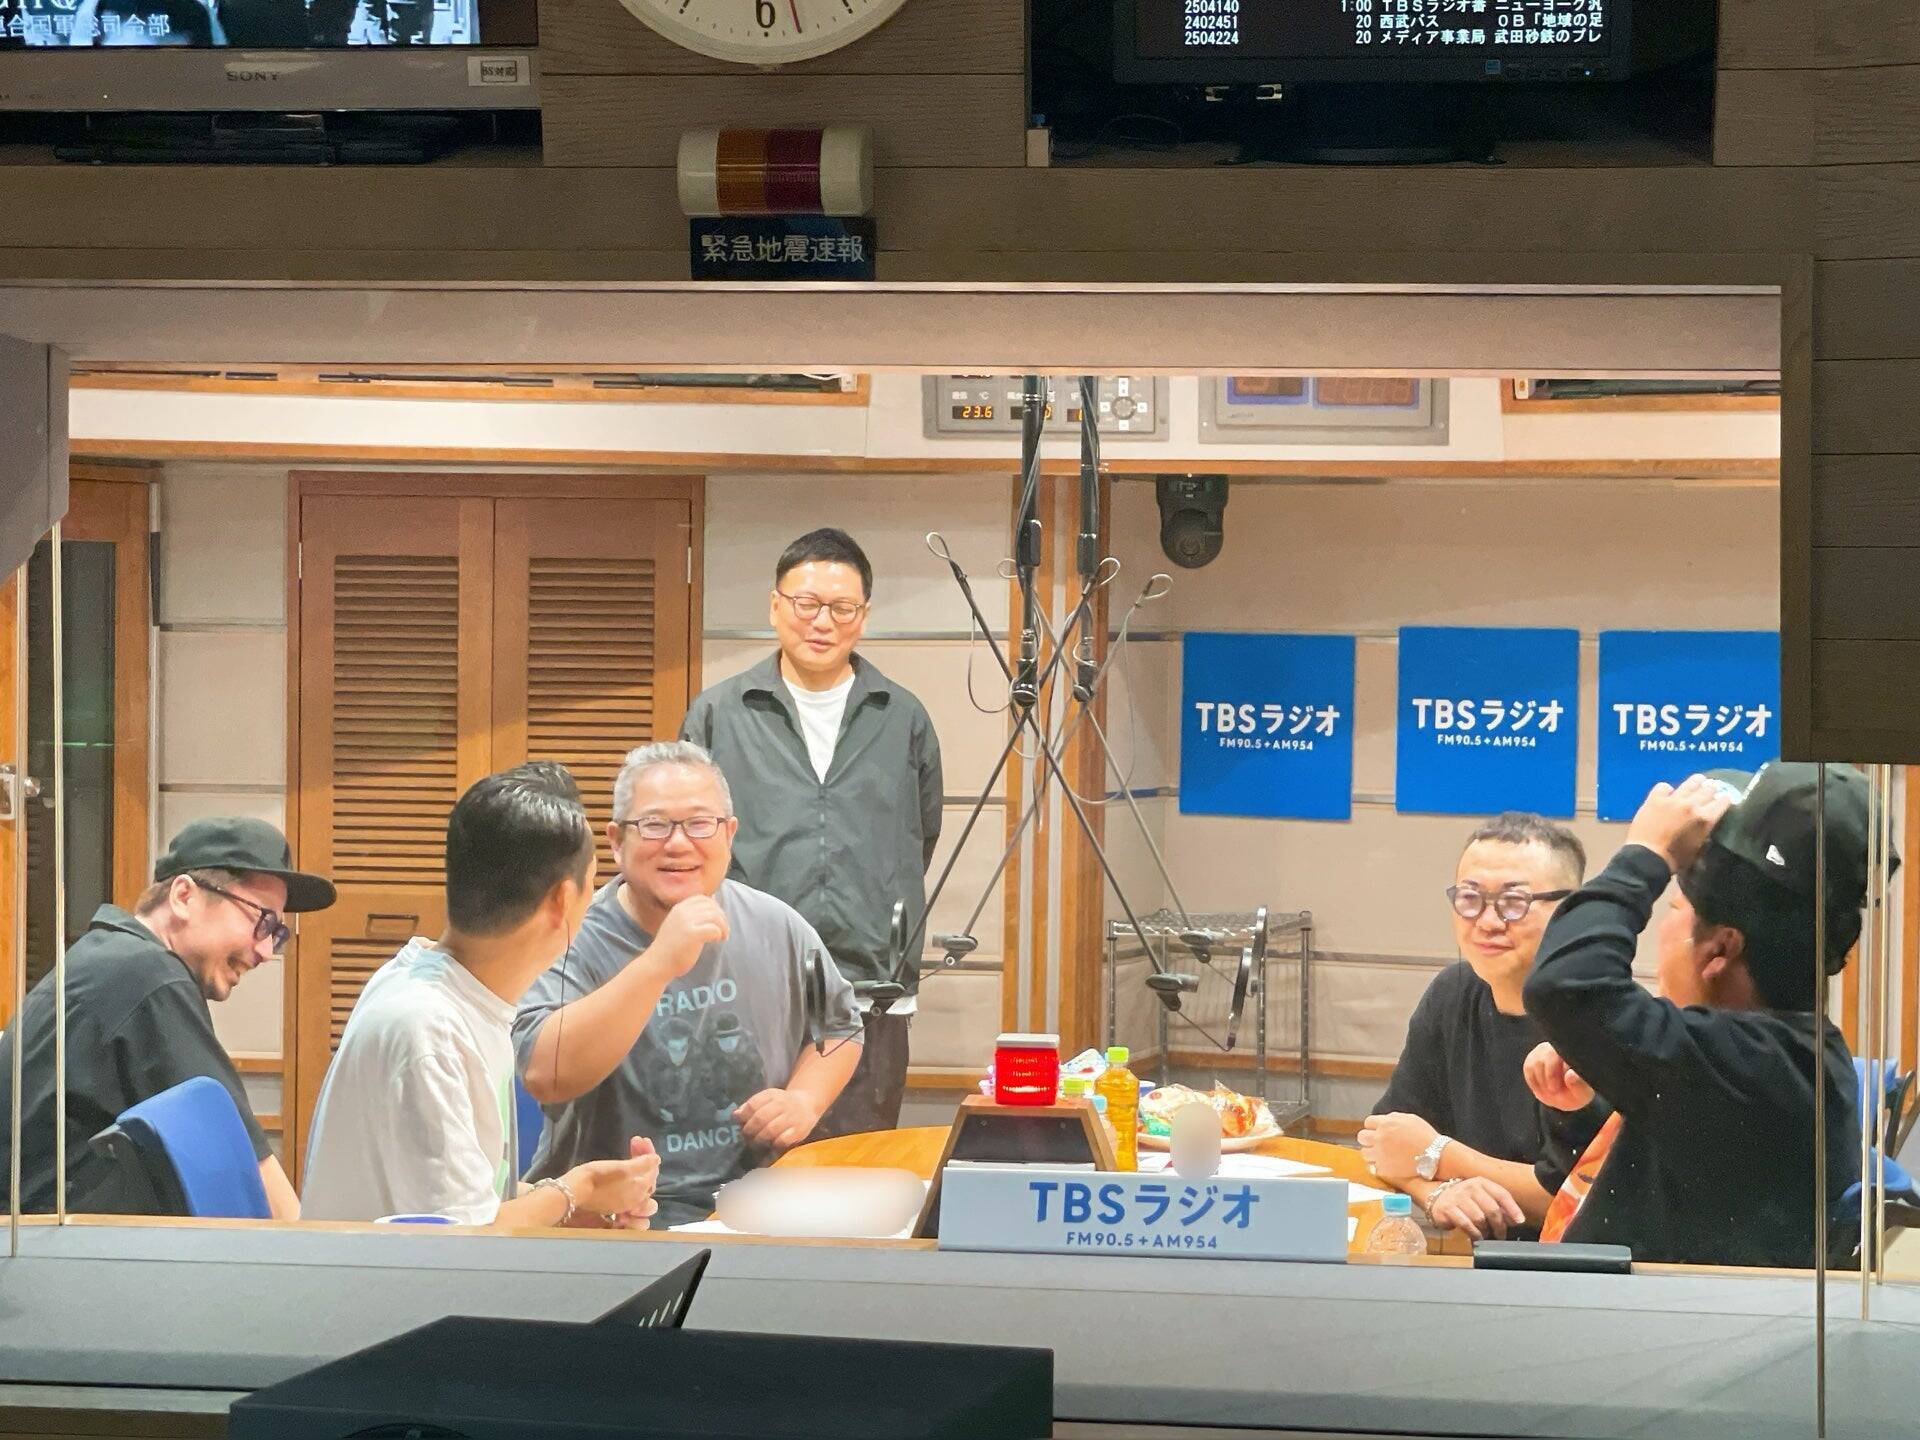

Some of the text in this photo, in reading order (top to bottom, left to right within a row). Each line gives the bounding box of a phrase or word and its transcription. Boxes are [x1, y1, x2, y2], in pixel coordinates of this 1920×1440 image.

[1184, 0, 1239, 13] 2504140
[1184, 15, 1238, 29] 2402451
[1356, 14, 1372, 28] 20
[1380, 14, 1439, 28] 西武バス
[1184, 28, 1601, 45] 2504224 20 メディア事業局 武田砂鉄のプレ
[226, 71, 280, 81] SONY
[700, 234, 865, 263] 緊急地震速報
[962, 405, 992, 418] 23.6
[1196, 702, 1340, 737] TBSラジオ
[1412, 698, 1564, 732] TBSラジオ
[1613, 703, 1772, 737] TBSラジオ
[656, 978, 737, 1017] RADIO
[1029, 1181, 1260, 1229] TBSラジオ
